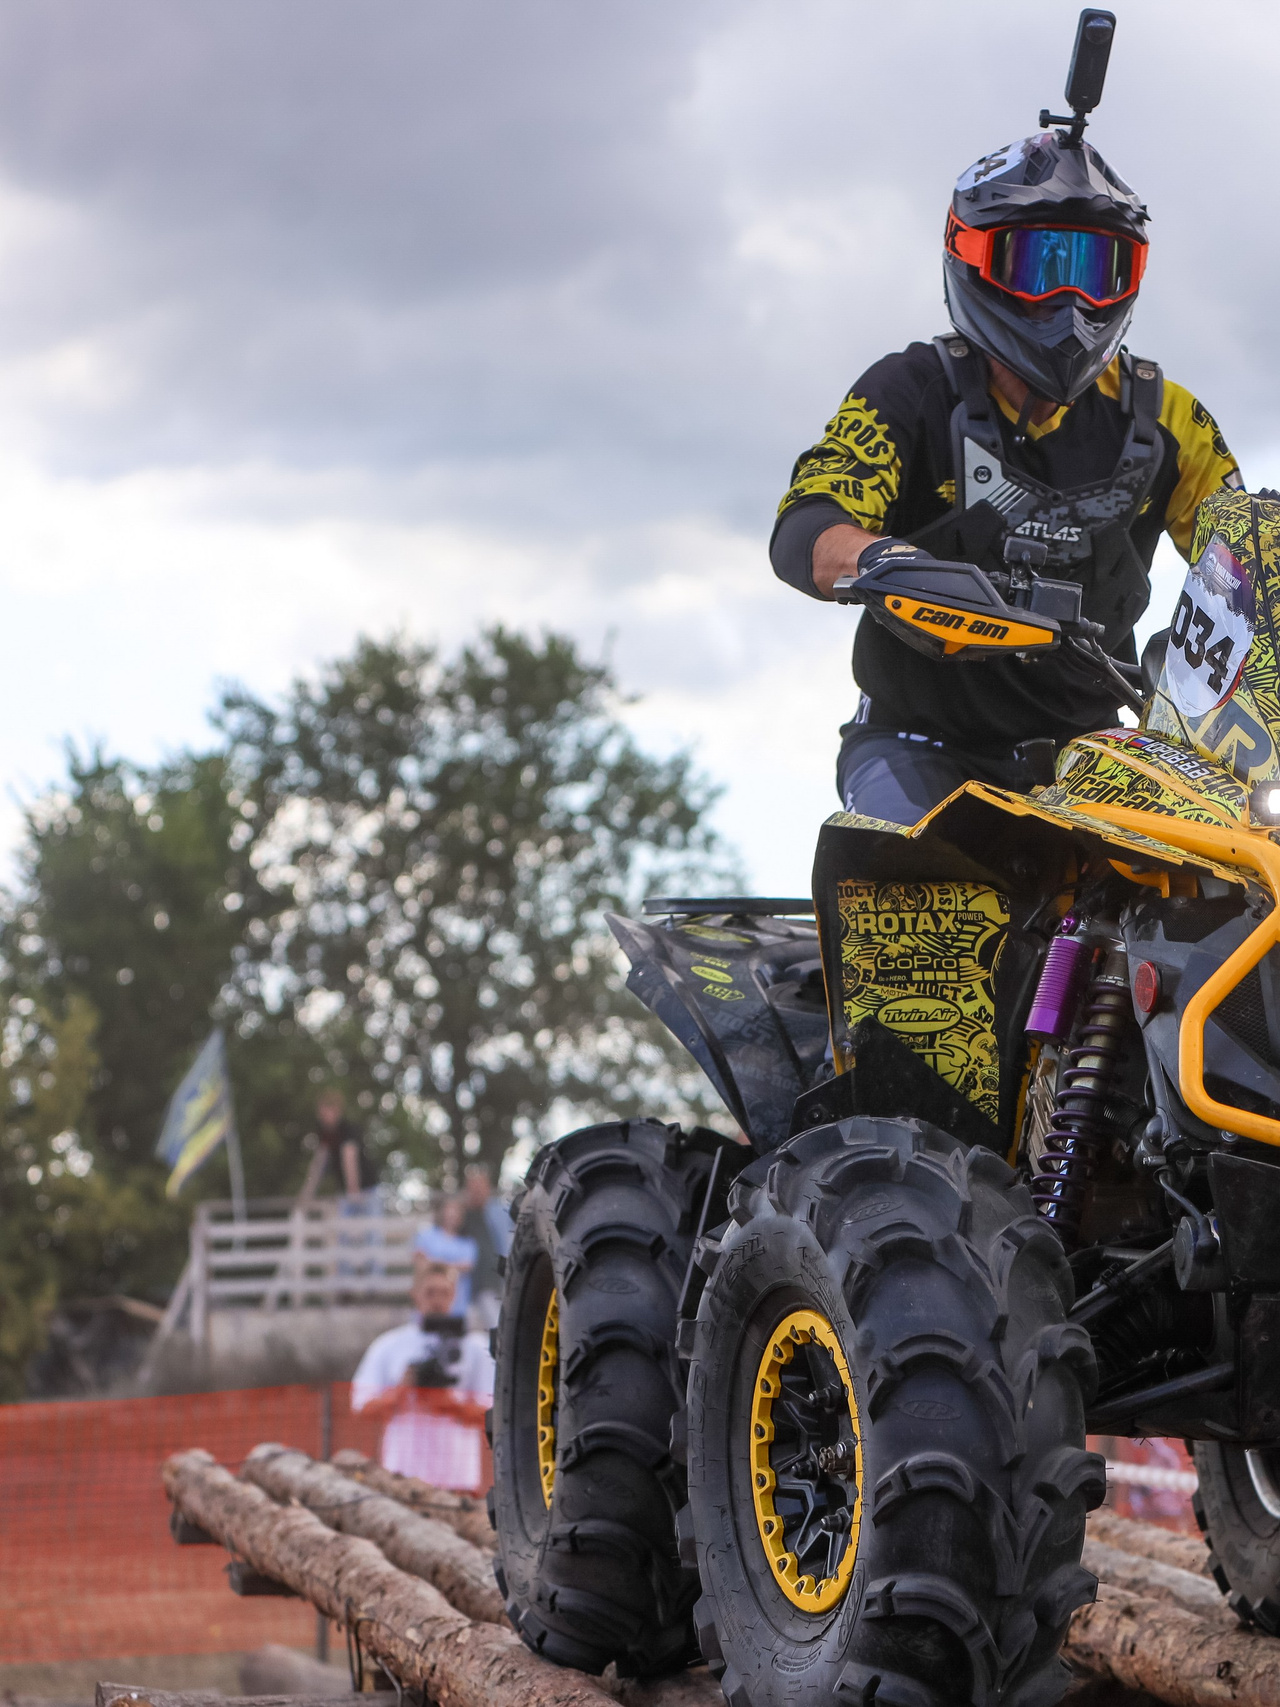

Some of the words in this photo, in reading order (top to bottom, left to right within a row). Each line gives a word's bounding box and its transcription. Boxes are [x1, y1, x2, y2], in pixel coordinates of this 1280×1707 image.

[1014, 520, 1082, 542] ATLAS
[911, 606, 1010, 640] can-am
[1170, 589, 1236, 696] 034
[857, 912, 957, 934] ROTAX
[957, 912, 983, 921] POWER
[877, 955, 957, 970] GoPro
[884, 1008, 928, 1023] Twin
[927, 1008, 959, 1023] Air
